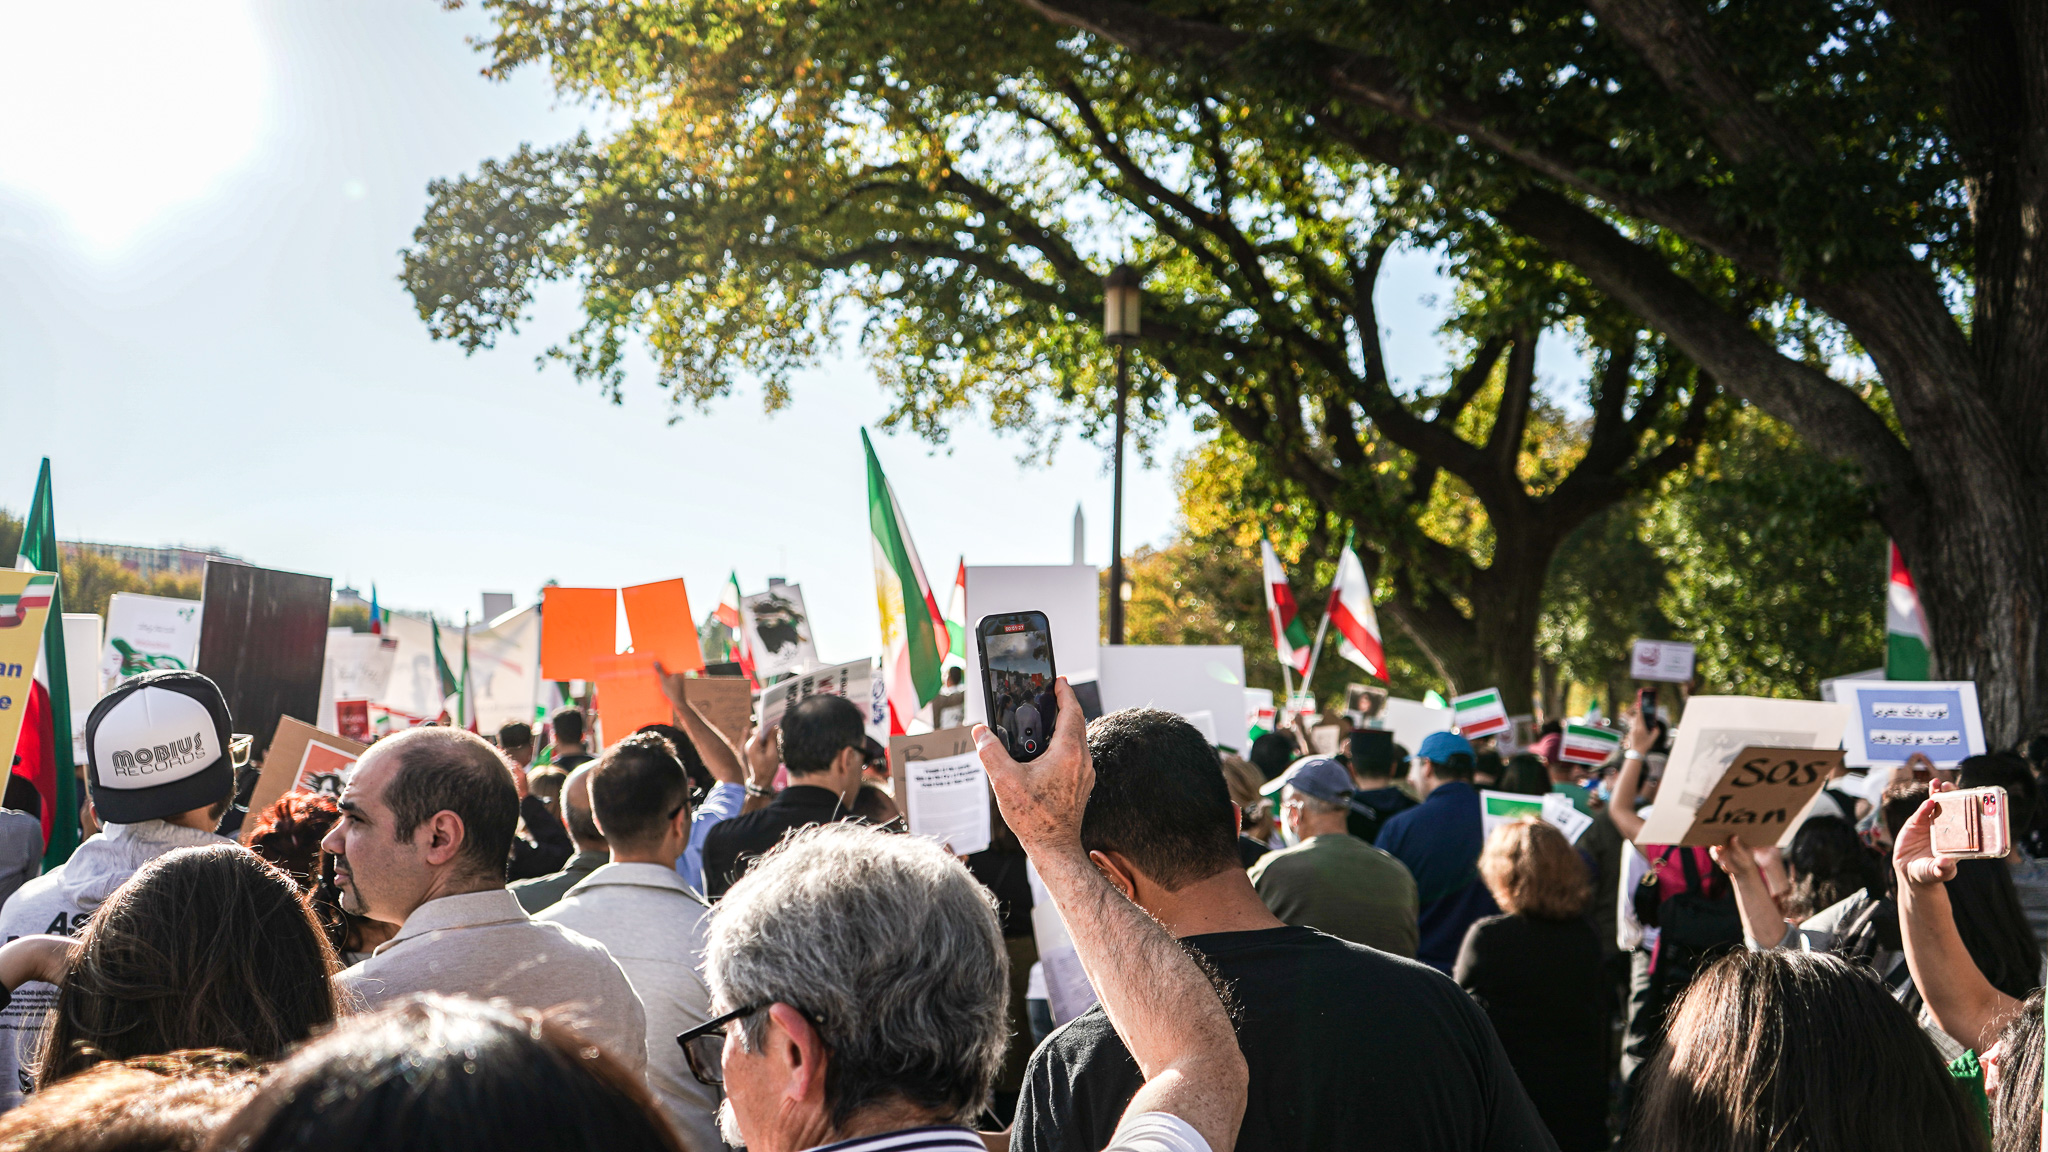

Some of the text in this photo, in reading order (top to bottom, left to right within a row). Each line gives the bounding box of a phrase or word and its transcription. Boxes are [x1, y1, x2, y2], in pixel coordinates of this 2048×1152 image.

[112, 732, 202, 768] MOBIUS
[114, 748, 206, 776] RECORDS
[1731, 757, 1828, 788] SOS
[1702, 795, 1787, 824] Iran
